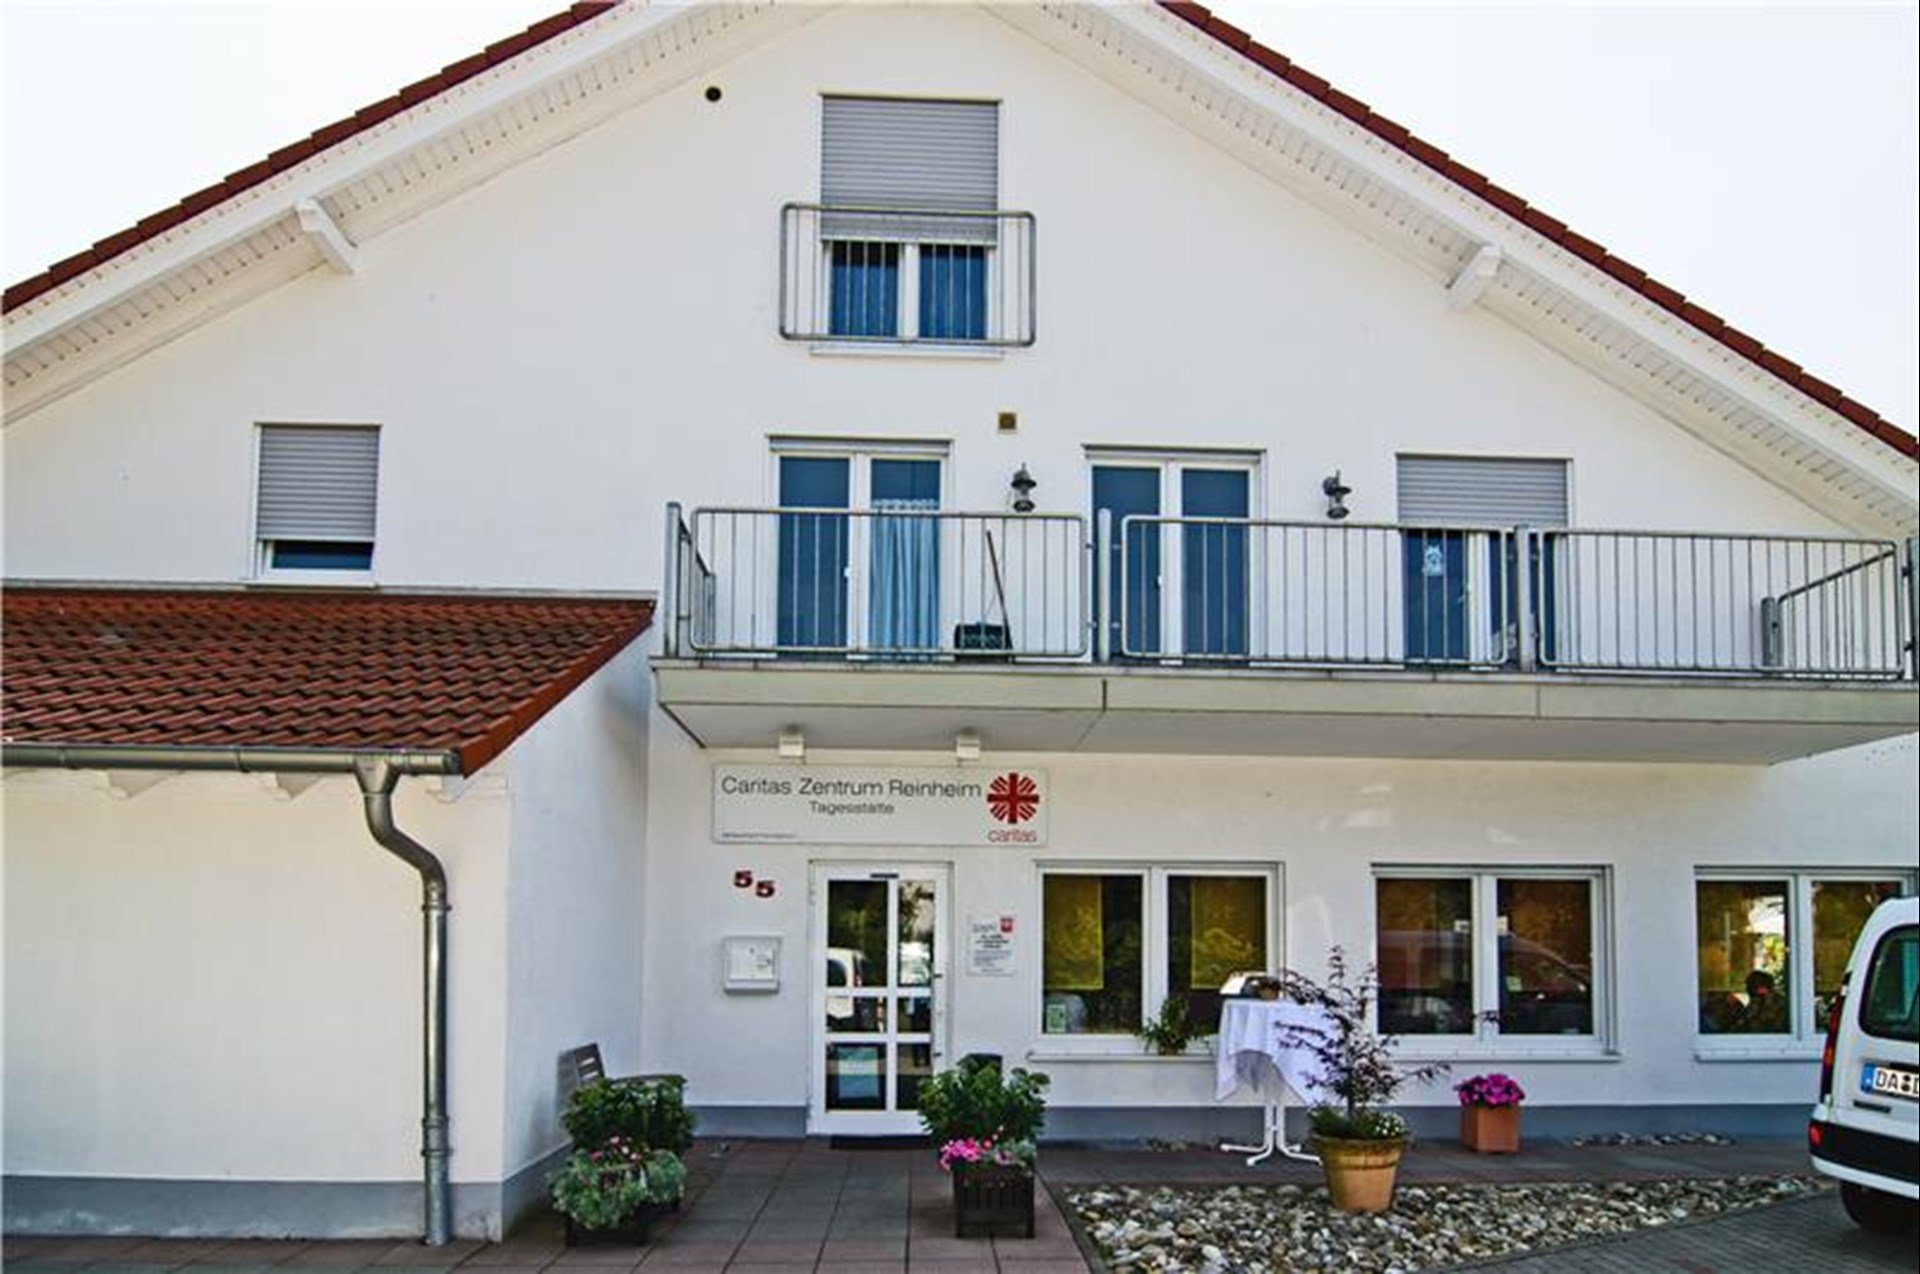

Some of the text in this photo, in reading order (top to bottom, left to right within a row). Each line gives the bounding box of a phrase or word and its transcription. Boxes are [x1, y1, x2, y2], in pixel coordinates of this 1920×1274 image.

[721, 776, 982, 797] Caritas Zentrum Reinheim
[987, 828, 1037, 843] caritas
